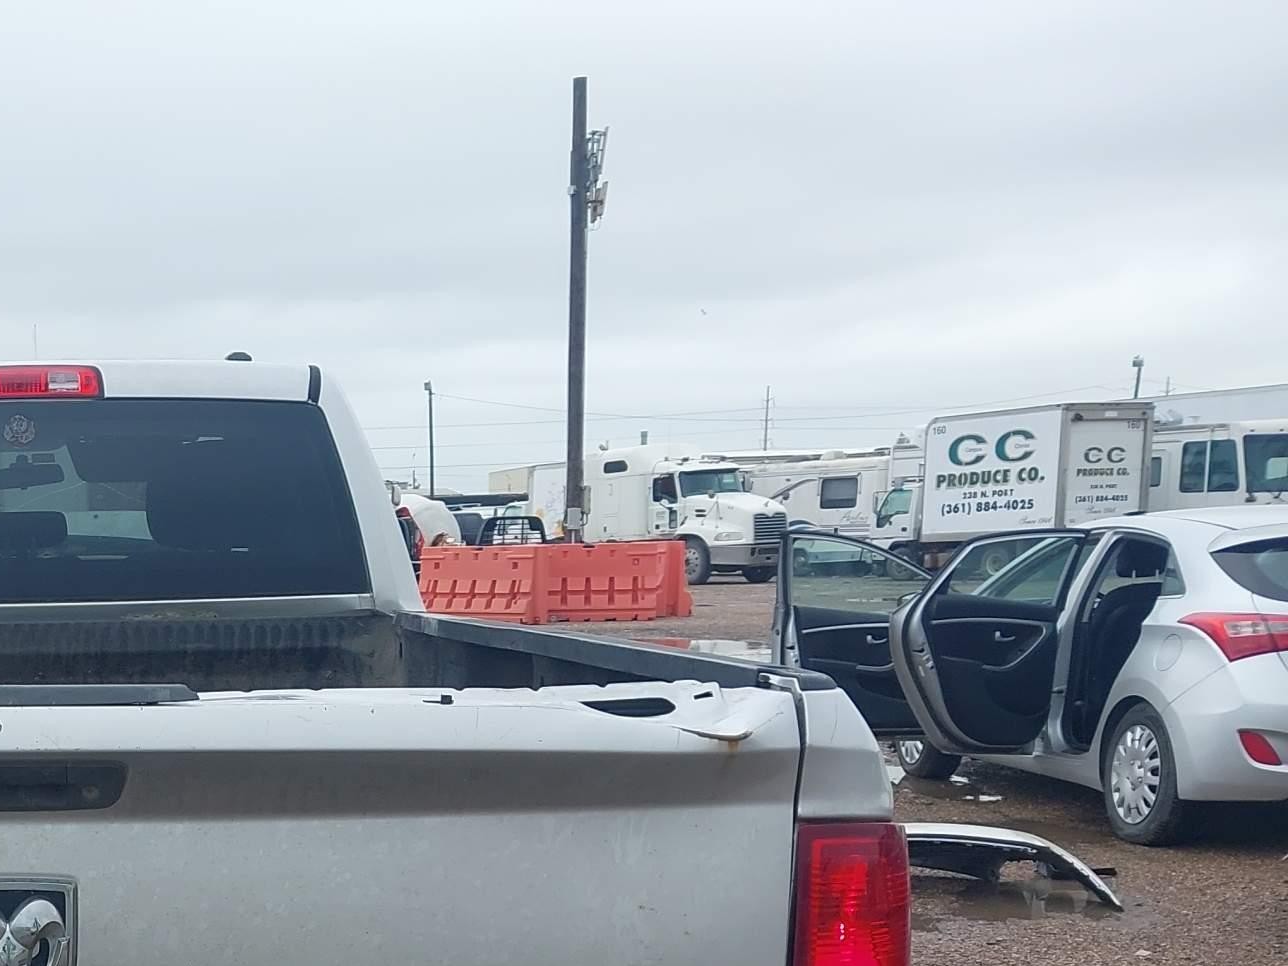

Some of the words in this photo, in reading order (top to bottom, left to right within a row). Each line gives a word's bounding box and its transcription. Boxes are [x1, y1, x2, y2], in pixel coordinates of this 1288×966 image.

[935, 469, 1011, 489] PRODUCE
[1017, 467, 1045, 484] CO.
[1076, 468, 1114, 477] PRODUCE
[941, 503, 972, 516] (361)
[976, 499, 1034, 512] 884-4025
